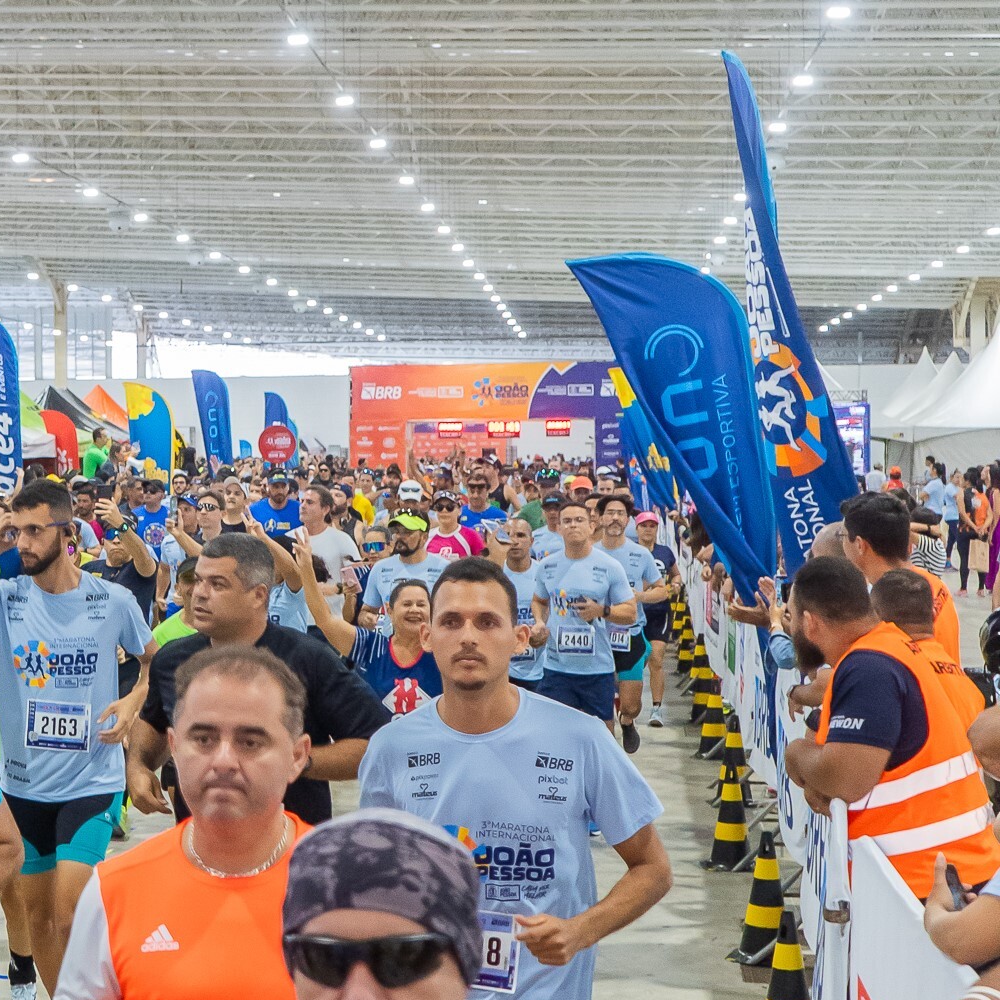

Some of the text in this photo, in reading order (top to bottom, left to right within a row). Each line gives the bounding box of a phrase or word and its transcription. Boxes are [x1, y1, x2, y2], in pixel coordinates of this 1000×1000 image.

[745, 206, 780, 356] PESSOA
[375, 386, 402, 400] BRB
[94, 593, 109, 601] BRB
[564, 634, 589, 647] 2440
[49, 649, 99, 666] JOÃO
[41, 716, 78, 737] 2163
[420, 752, 441, 767] BRB
[549, 757, 574, 771] BRB
[538, 774, 568, 785] pixbet
[411, 790, 438, 798] mateus
[538, 793, 567, 801] mateus
[475, 829, 557, 842] INTERNACIONAL
[473, 842, 555, 868] JOÃO
[477, 866, 556, 882] PESSOA
[486, 936, 502, 966] 8
